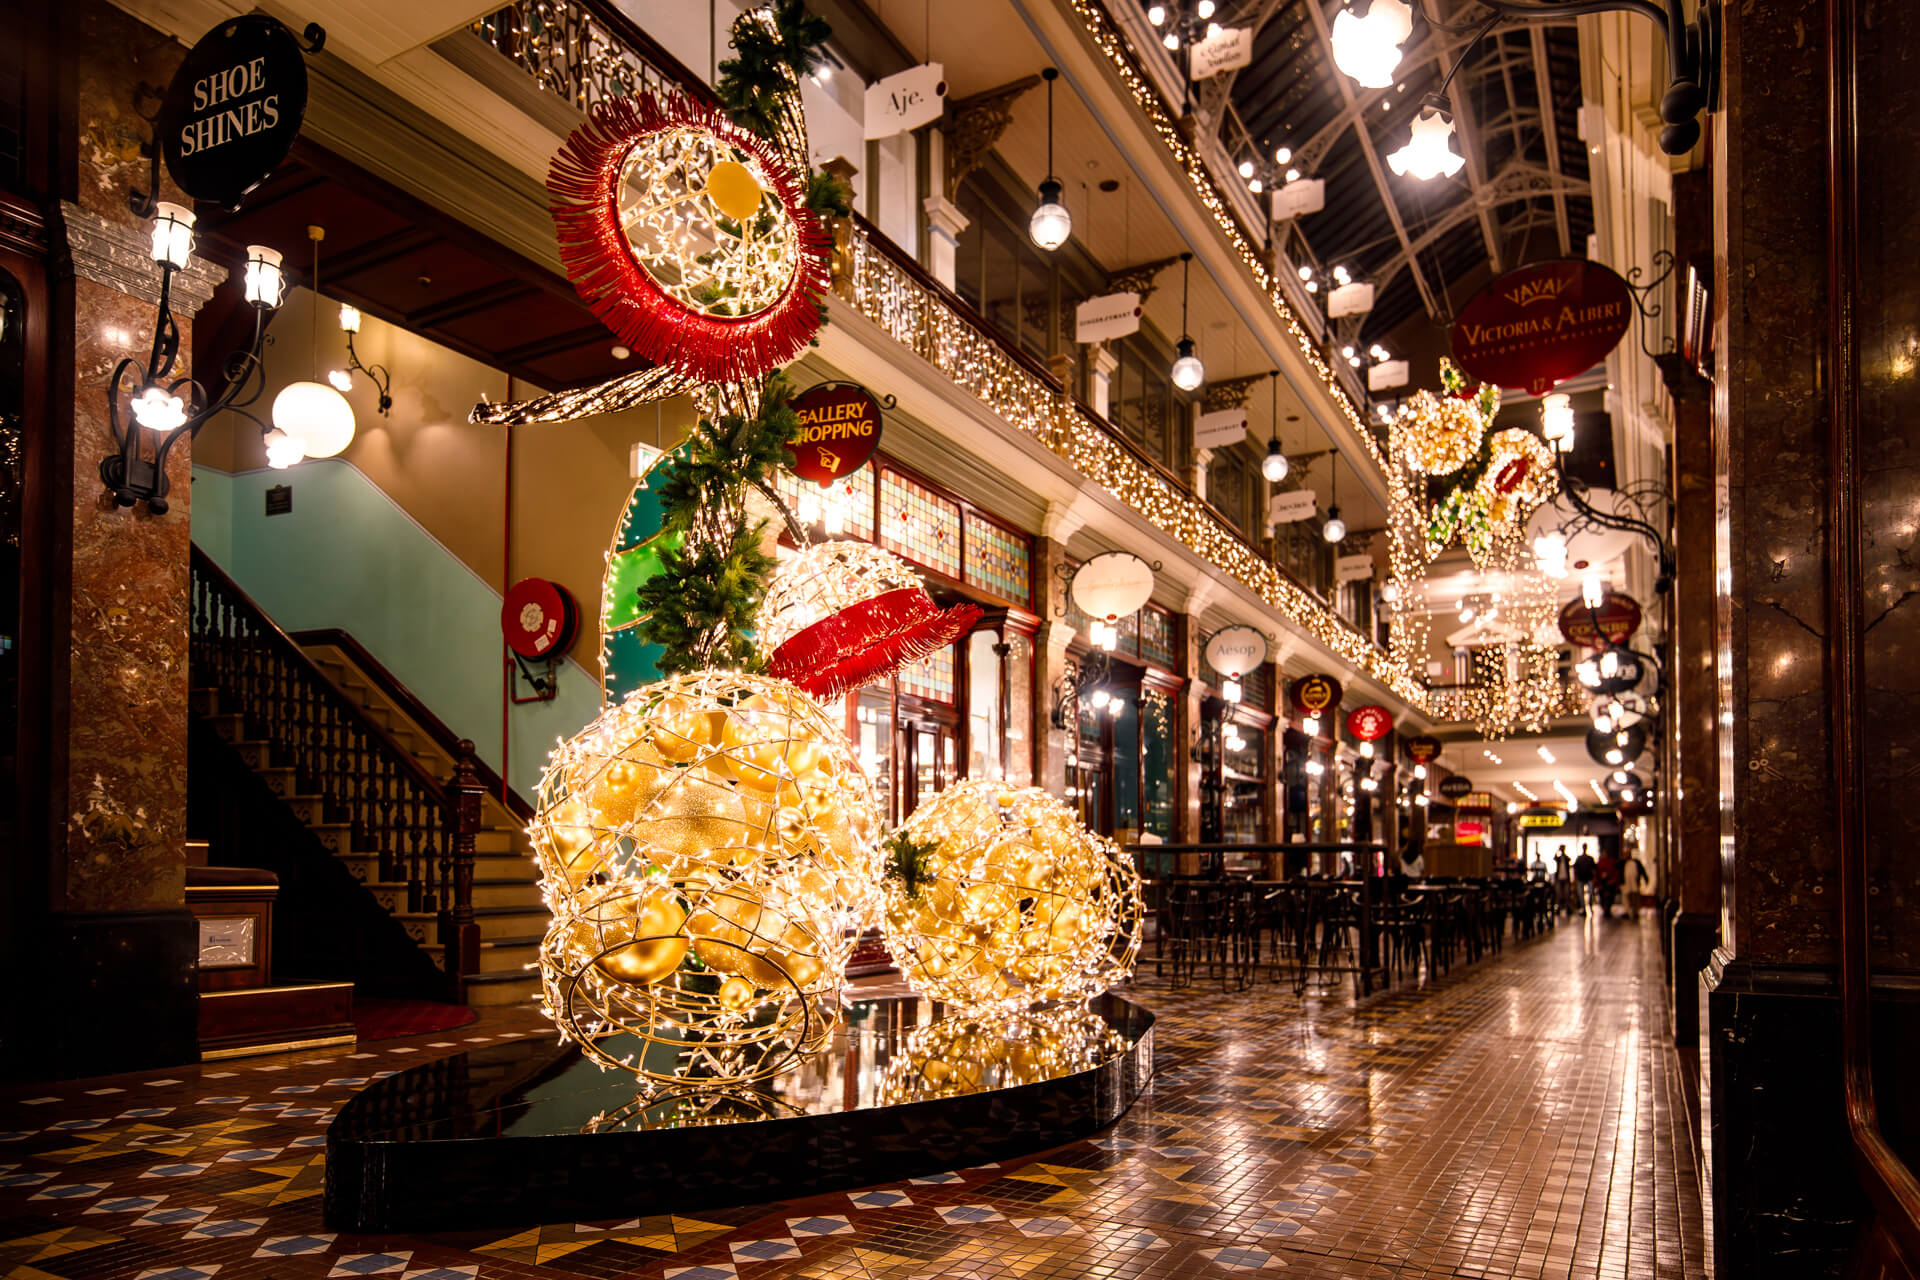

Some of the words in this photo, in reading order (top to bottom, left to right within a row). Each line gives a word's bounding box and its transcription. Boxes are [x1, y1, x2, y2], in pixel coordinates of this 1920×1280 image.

[193, 56, 265, 112] SHOE
[885, 88, 924, 116] Aje.
[181, 94, 279, 158] SHINES
[1461, 319, 1541, 346] VICTORIA
[1541, 316, 1552, 331] &
[1555, 301, 1623, 333] ALBERT
[797, 401, 867, 425] GALLERY
[786, 420, 873, 445] HOPPING
[1216, 644, 1256, 657] Aesop
